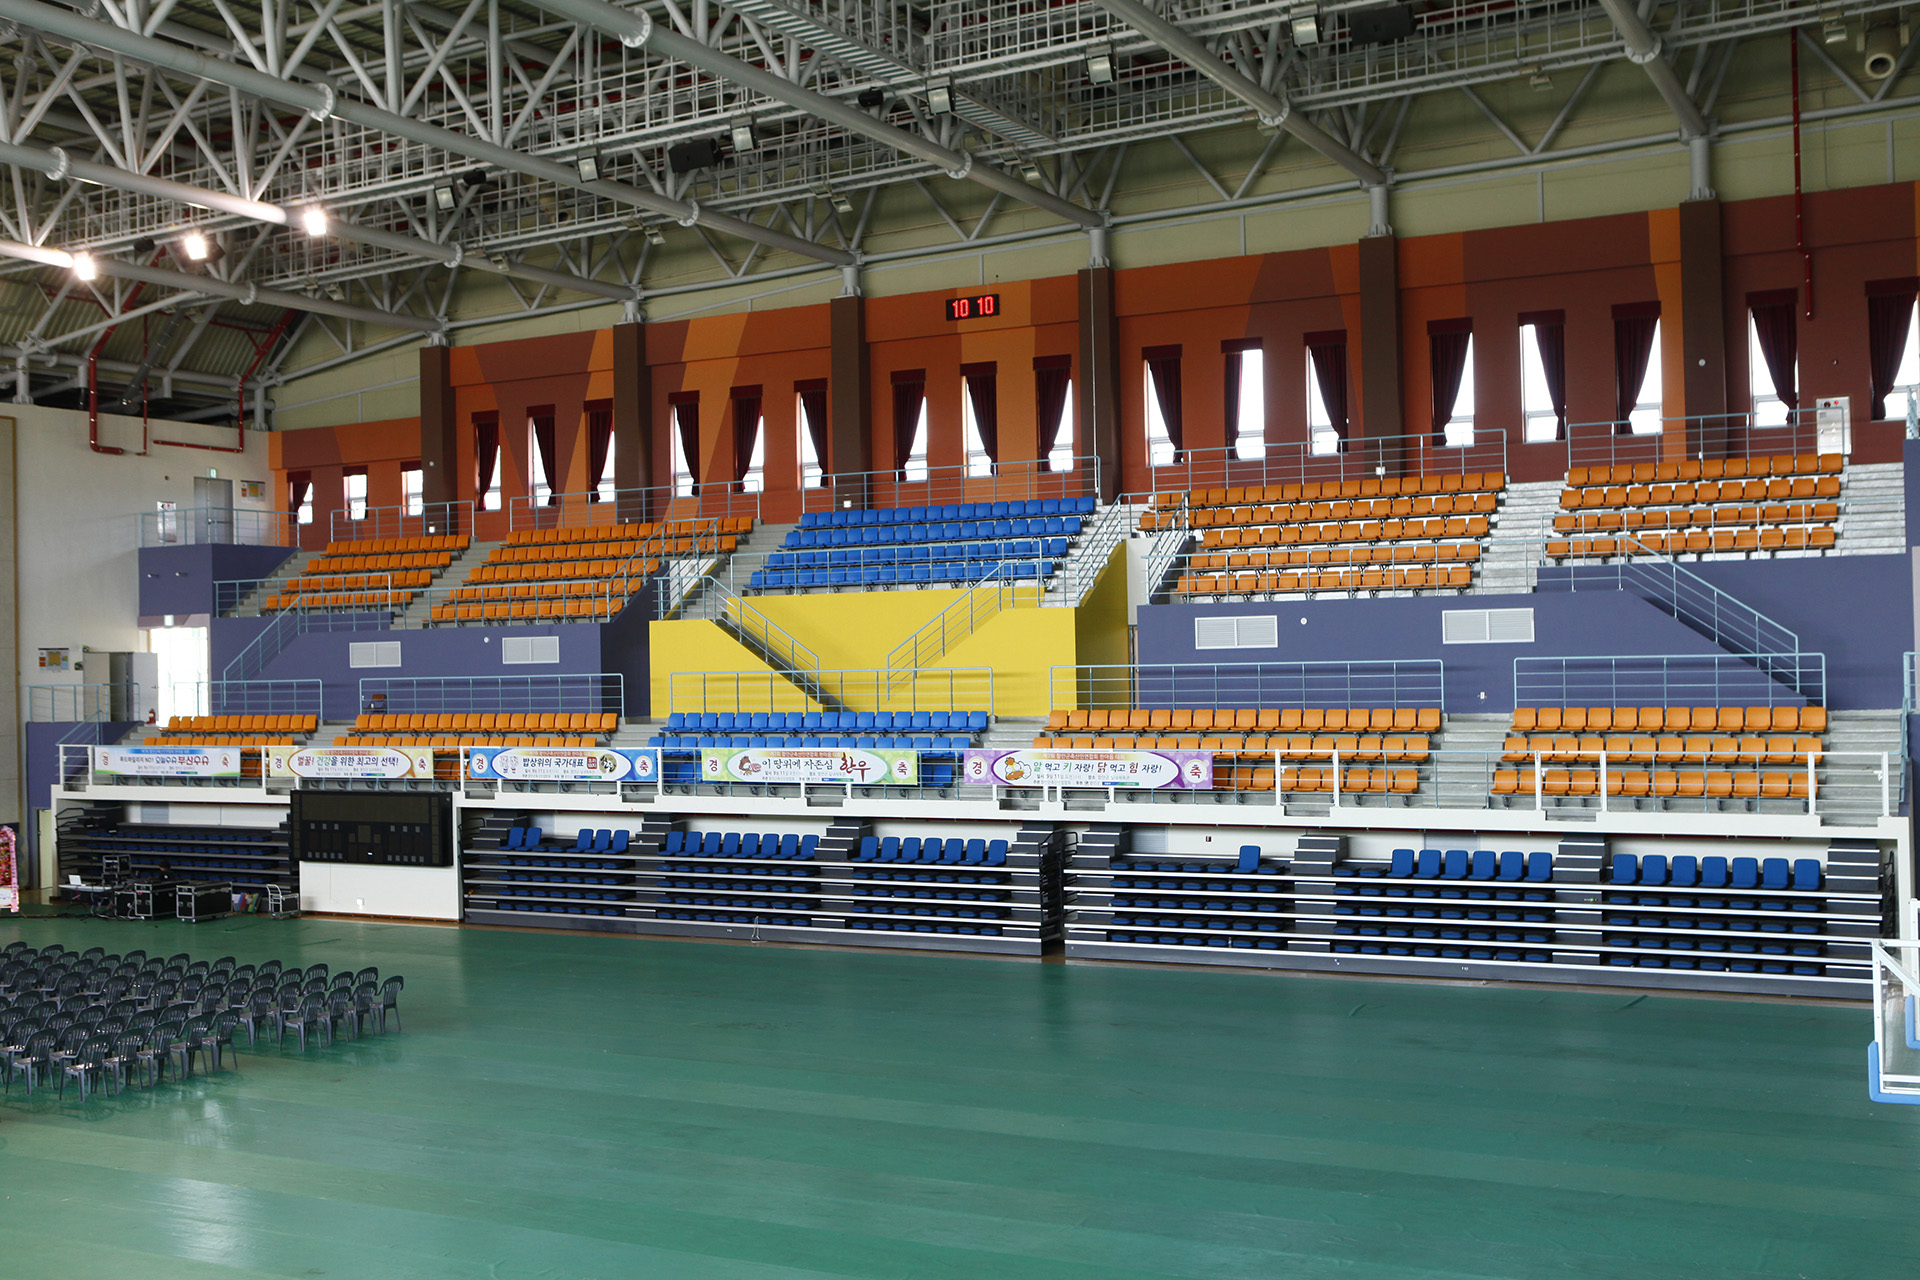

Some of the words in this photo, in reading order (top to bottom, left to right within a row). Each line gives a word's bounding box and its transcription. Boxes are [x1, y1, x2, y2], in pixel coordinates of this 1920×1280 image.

[952, 298, 969, 318] 10
[976, 295, 995, 316] 10
[178, 756, 210, 766] 부산우유
[275, 757, 282, 769] 경
[297, 756, 314, 766] 벌꿀!
[317, 756, 338, 767] 건강을
[340, 756, 355, 767] 위한
[356, 756, 378, 767] 최고의
[381, 756, 399, 767] 선택!
[476, 758, 484, 770] 경
[523, 758, 552, 768] 밥상위의
[554, 758, 584, 768] 국가대표
[709, 759, 718, 772] 경
[762, 758, 771, 769] 이
[773, 758, 801, 770] 땅위에
[804, 759, 833, 770] 자존심
[897, 761, 908, 776] 축
[972, 761, 982, 775] 경
[1033, 761, 1043, 772] 알
[1045, 763, 1061, 773] 먹고
[1063, 762, 1072, 773] 키
[1074, 763, 1095, 773] 자랑!
[1097, 762, 1107, 774] 닭
[1109, 763, 1126, 773] 먹고
[1129, 762, 1139, 774] 힘
[1141, 763, 1163, 774] 자랑!
[1189, 764, 1202, 779] 축
